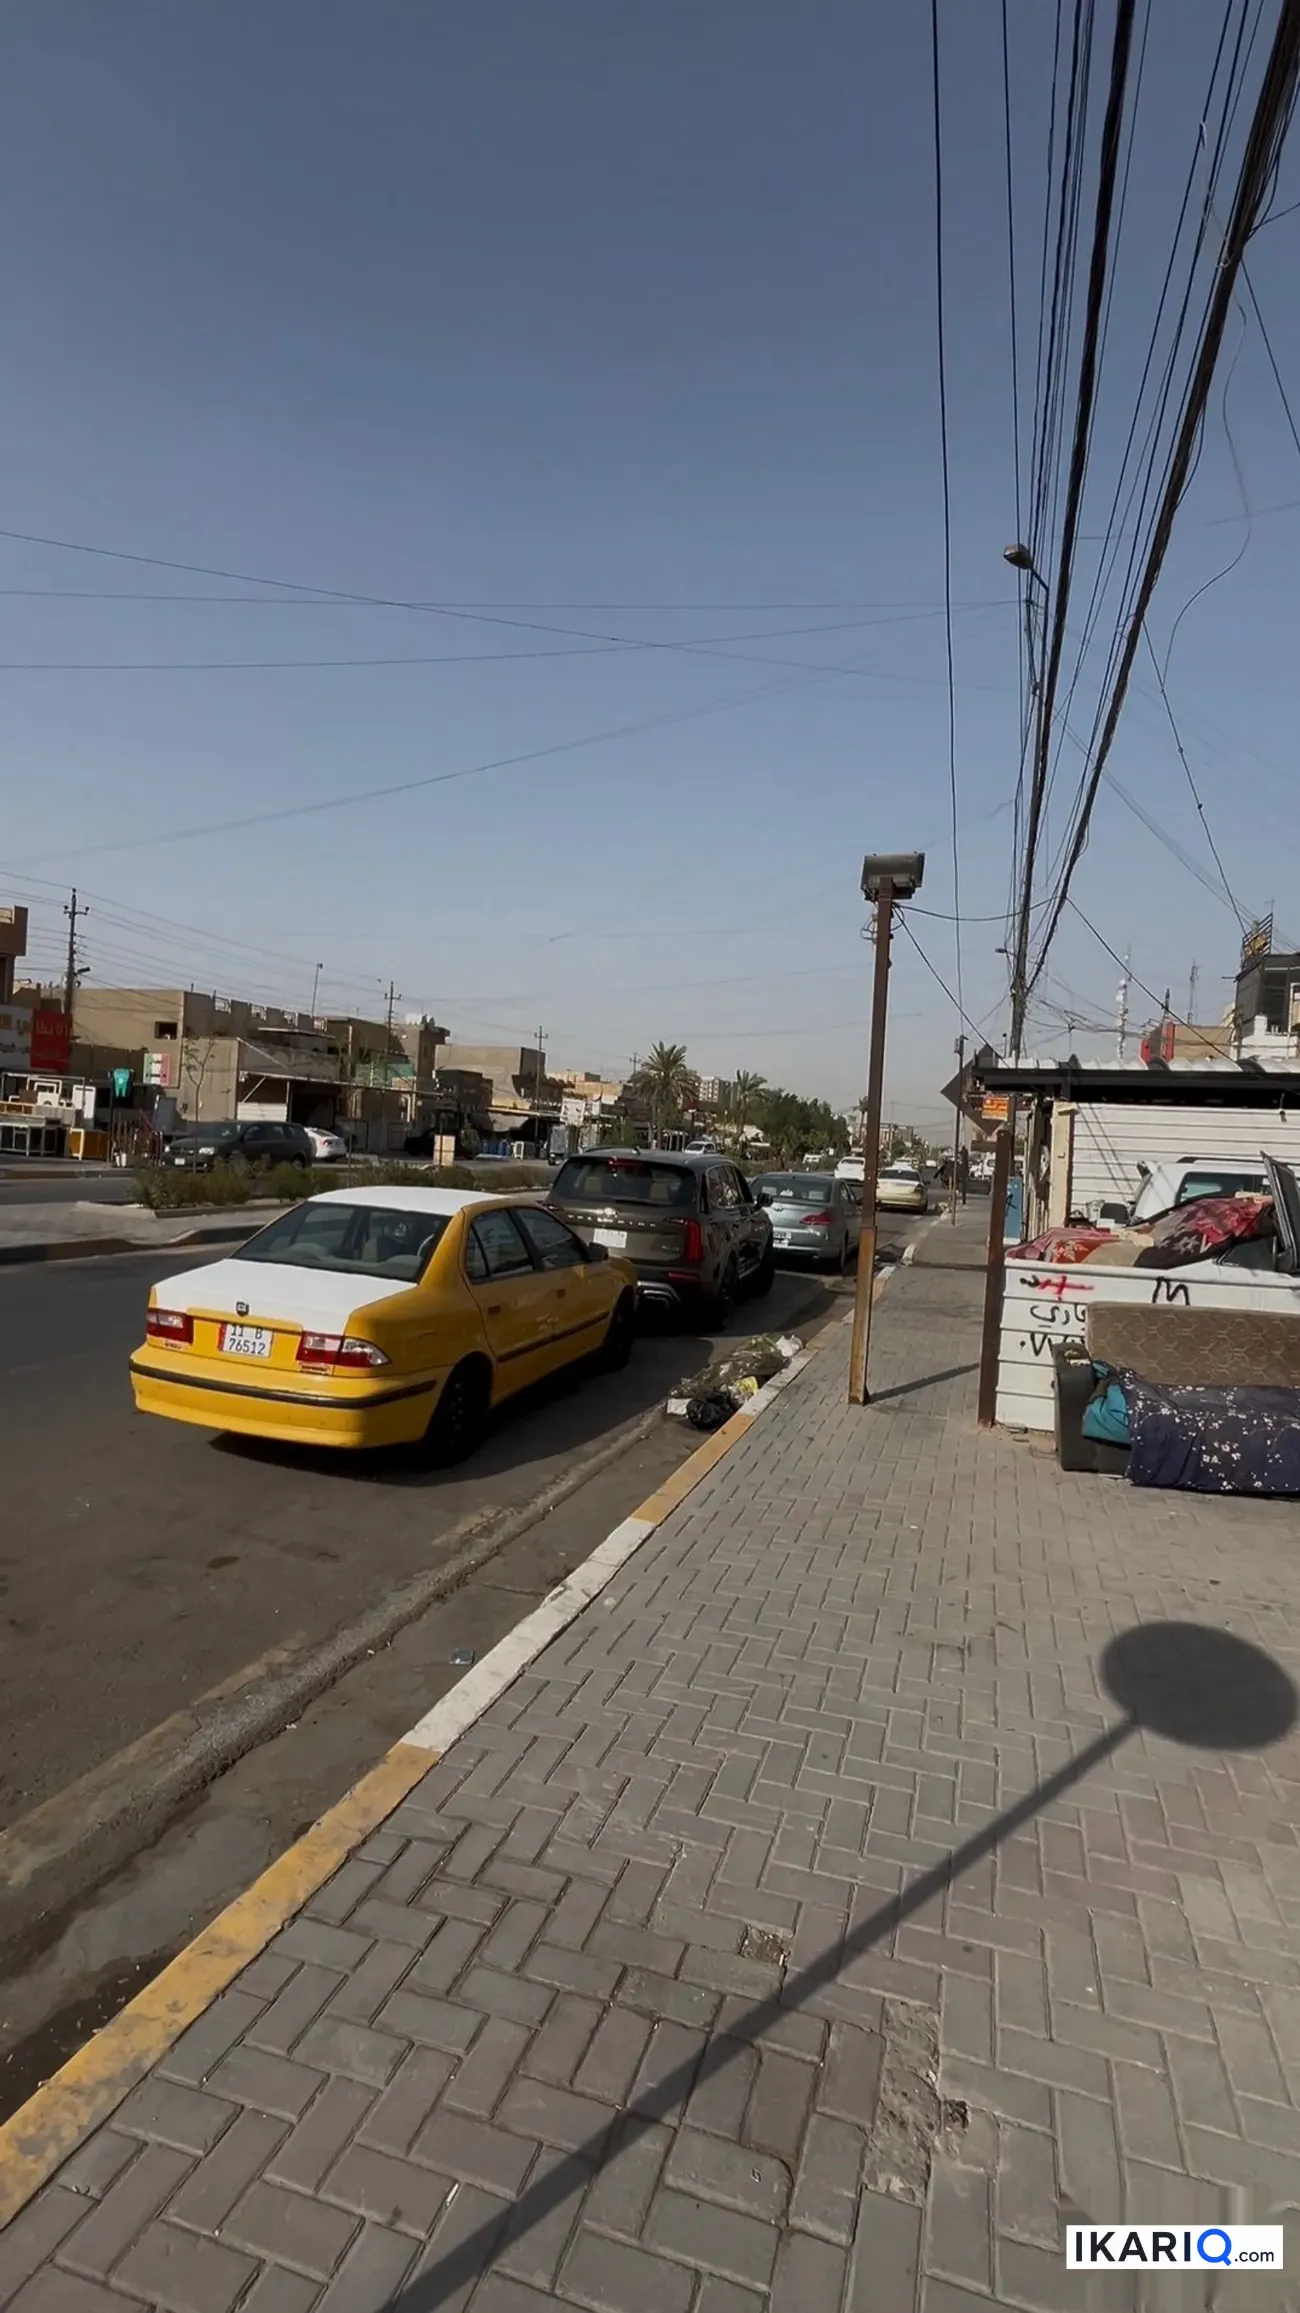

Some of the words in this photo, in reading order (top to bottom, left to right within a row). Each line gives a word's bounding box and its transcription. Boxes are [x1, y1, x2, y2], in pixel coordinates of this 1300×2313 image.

[231, 1322, 244, 1336] 11
[254, 1325, 264, 1339] B
[228, 1337, 266, 1355] 76512
